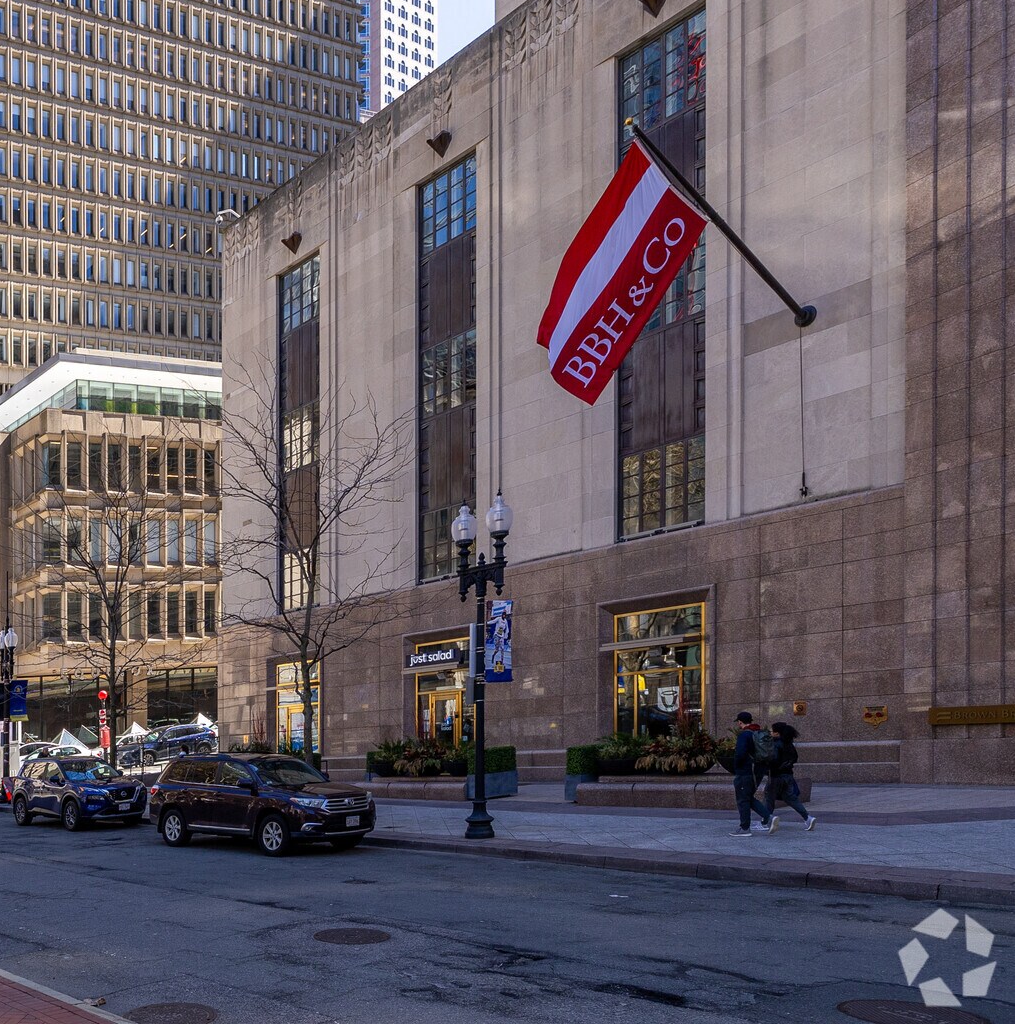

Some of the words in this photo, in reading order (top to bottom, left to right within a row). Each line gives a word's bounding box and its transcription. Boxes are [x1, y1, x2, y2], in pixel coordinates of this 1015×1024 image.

[561, 297, 635, 388] BBH
[628, 276, 654, 306] &
[410, 653, 427, 666] just
[428, 648, 453, 662] salad
[954, 711, 995, 719] BROWN
